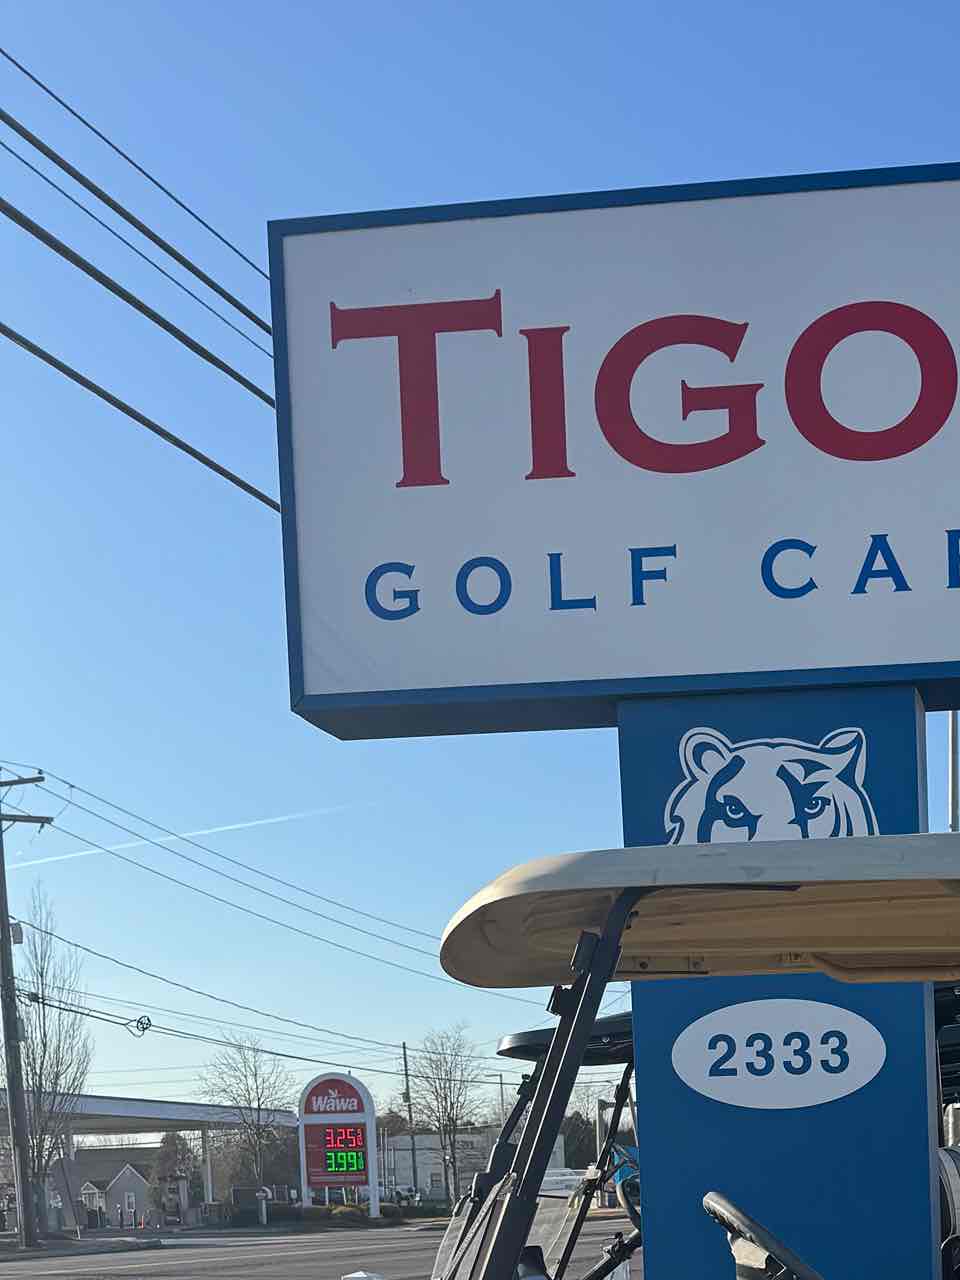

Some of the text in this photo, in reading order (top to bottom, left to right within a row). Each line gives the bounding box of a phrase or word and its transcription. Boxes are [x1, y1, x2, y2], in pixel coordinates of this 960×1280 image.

[364, 544, 676, 621] GOLF
[708, 1031, 848, 1076] 2333
[312, 1095, 358, 1112] Wawa
